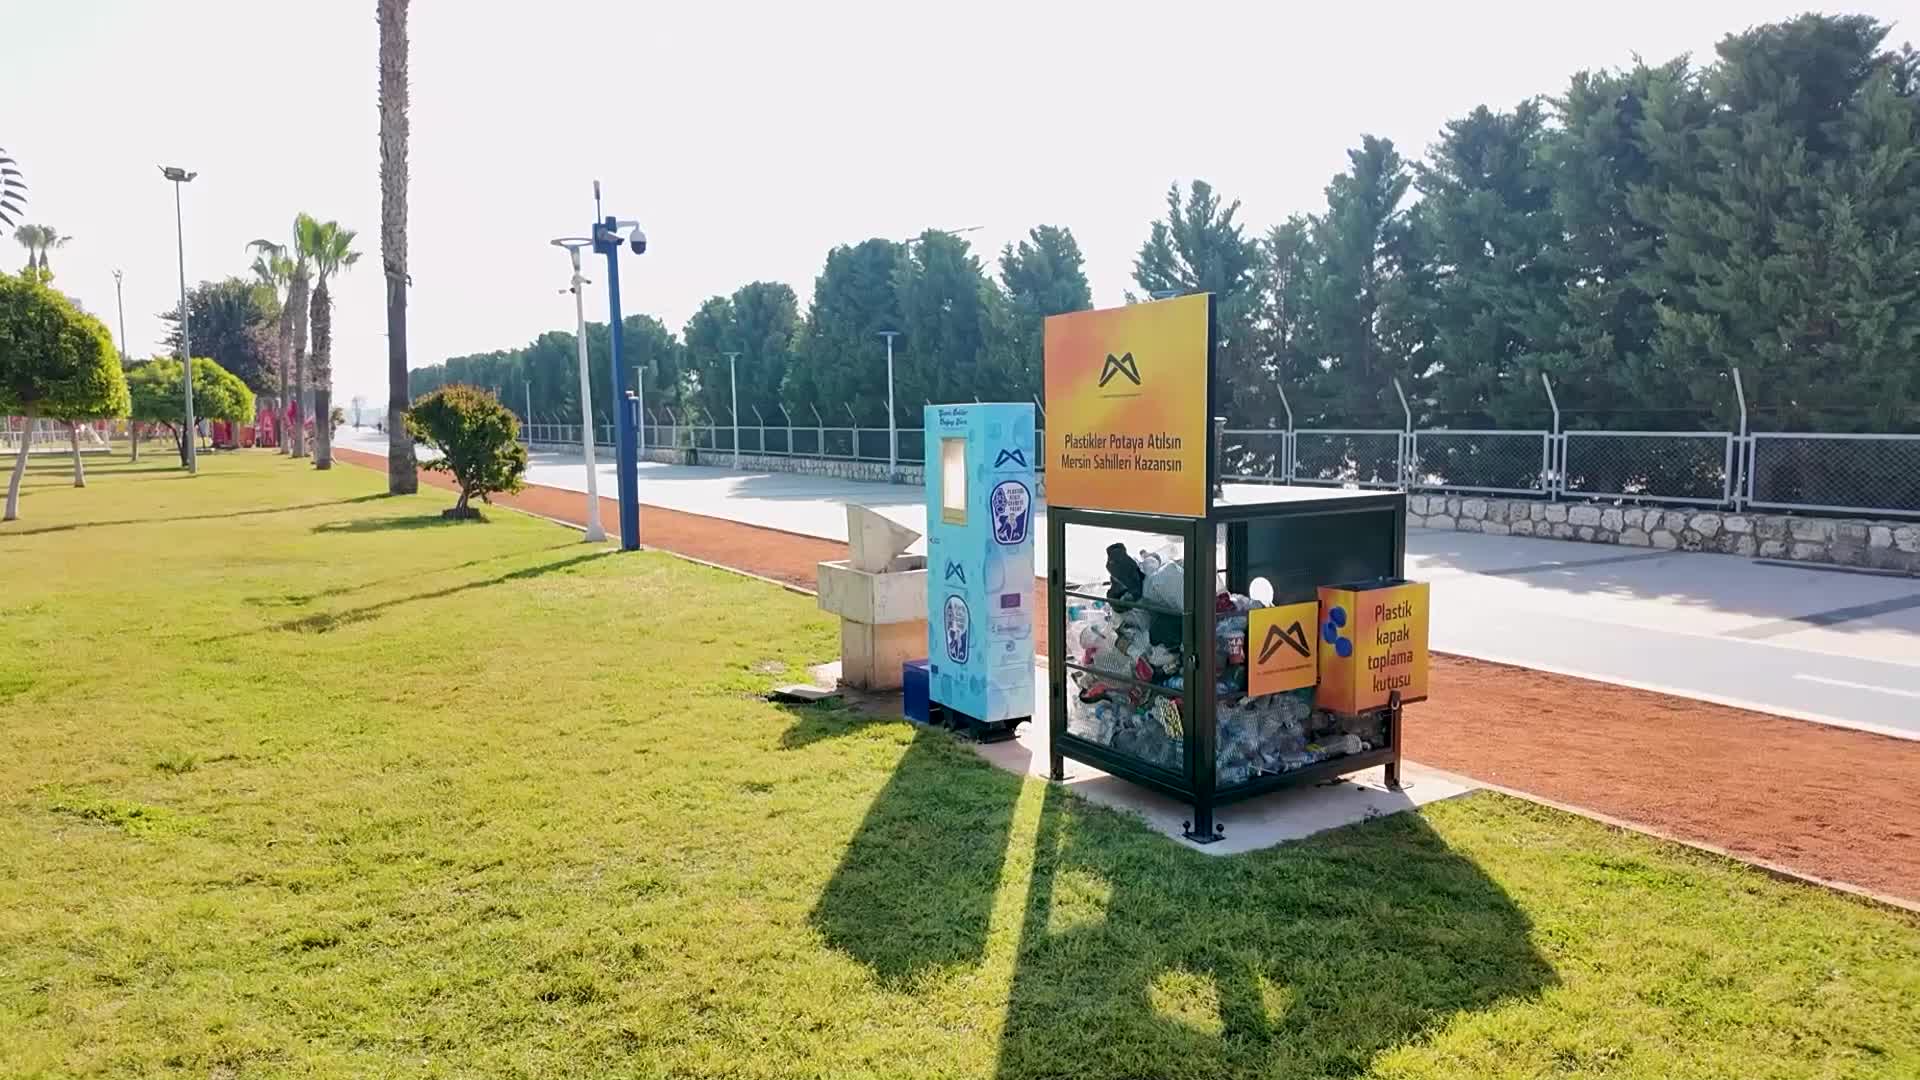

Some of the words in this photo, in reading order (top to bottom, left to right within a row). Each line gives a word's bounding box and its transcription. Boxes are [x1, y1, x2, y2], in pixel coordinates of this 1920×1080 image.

[1064, 432, 1107, 449] Plastikler
[1109, 433, 1144, 453] Potaya
[1147, 431, 1182, 450] Atılsın
[1061, 454, 1091, 469] Mersin
[1093, 453, 1132, 470] Sahilleri
[1134, 455, 1182, 472] Kazansın
[1375, 600, 1412, 622] Plastik
[1376, 624, 1410, 648] kapak
[1367, 648, 1413, 672] toplama
[1373, 672, 1411, 693] kutusu
